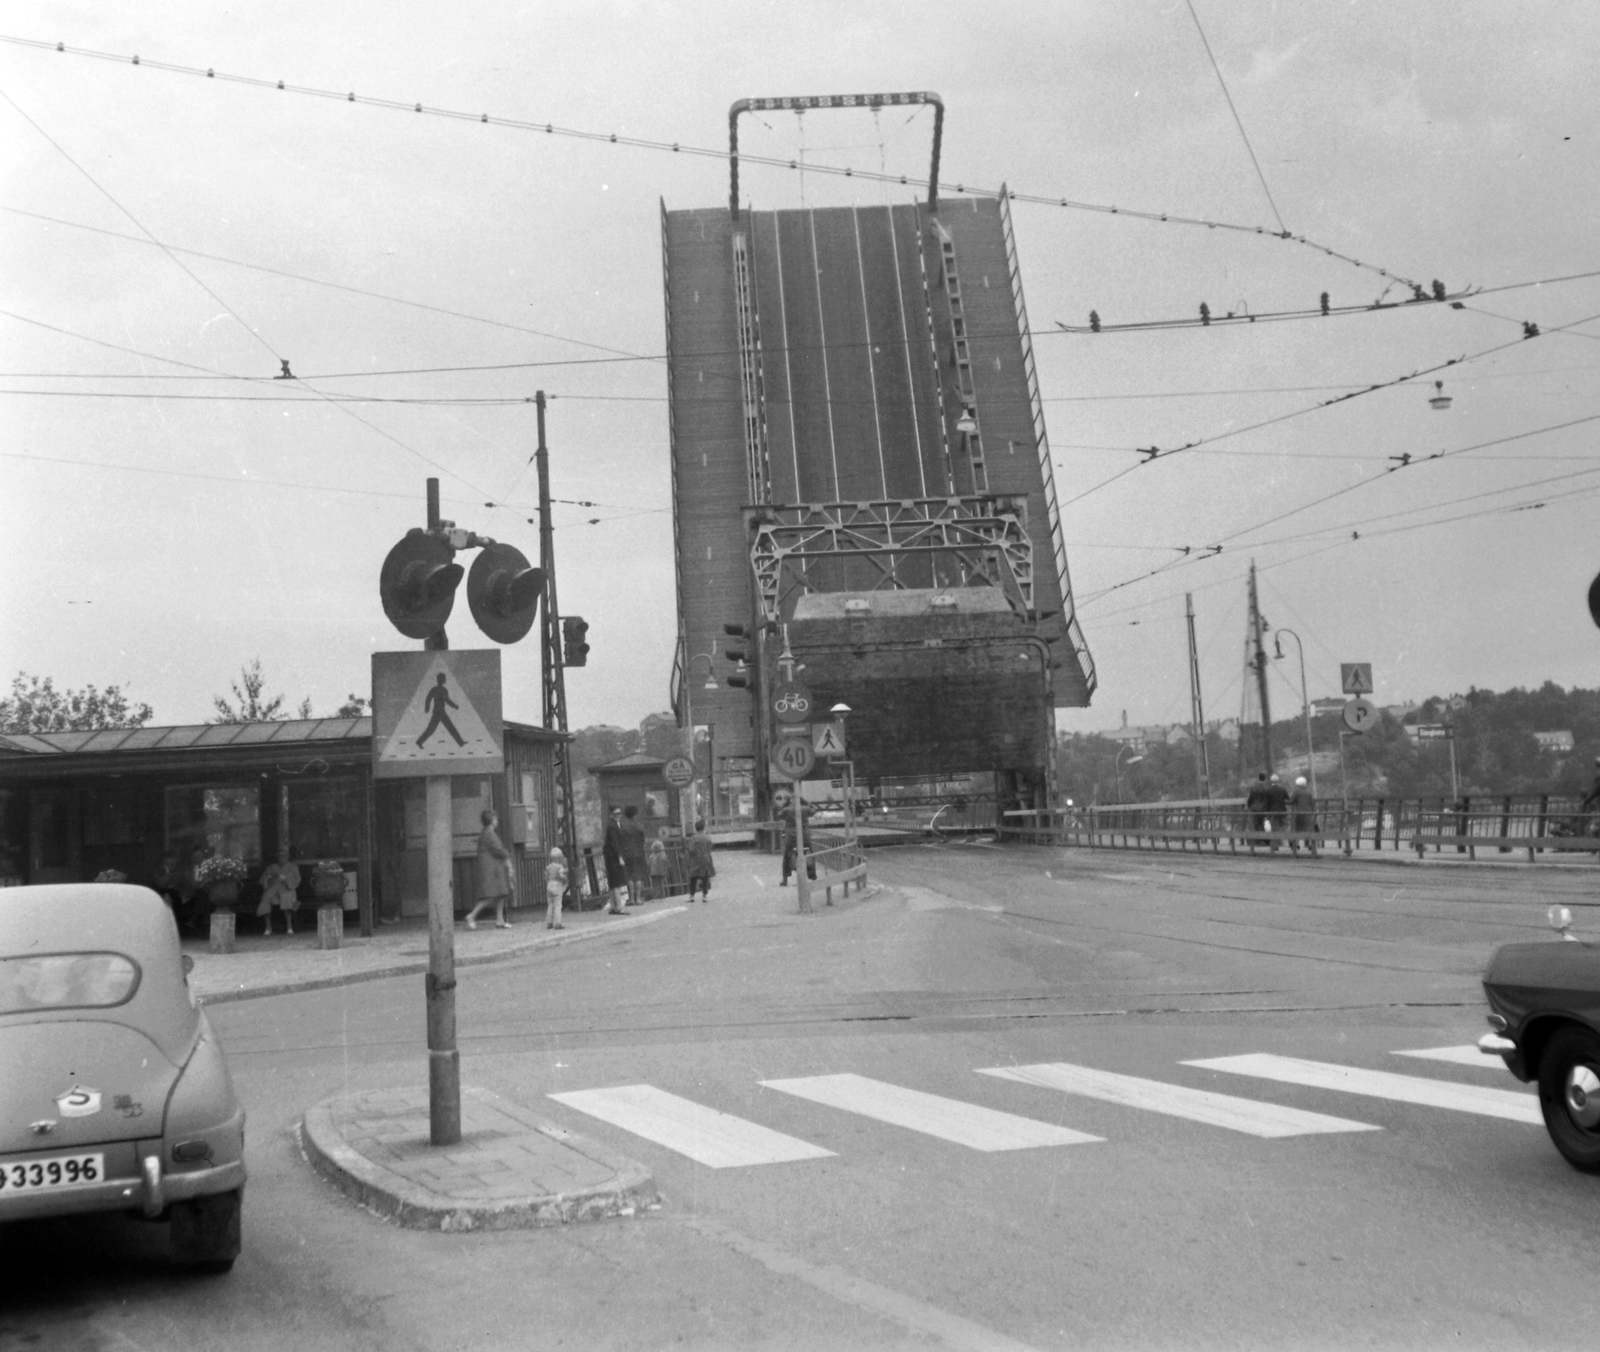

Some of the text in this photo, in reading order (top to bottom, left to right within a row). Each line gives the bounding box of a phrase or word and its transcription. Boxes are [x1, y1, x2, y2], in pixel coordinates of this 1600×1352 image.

[1356, 707, 1368, 723] P
[672, 760, 685, 769] GÅ
[783, 747, 805, 768] 40
